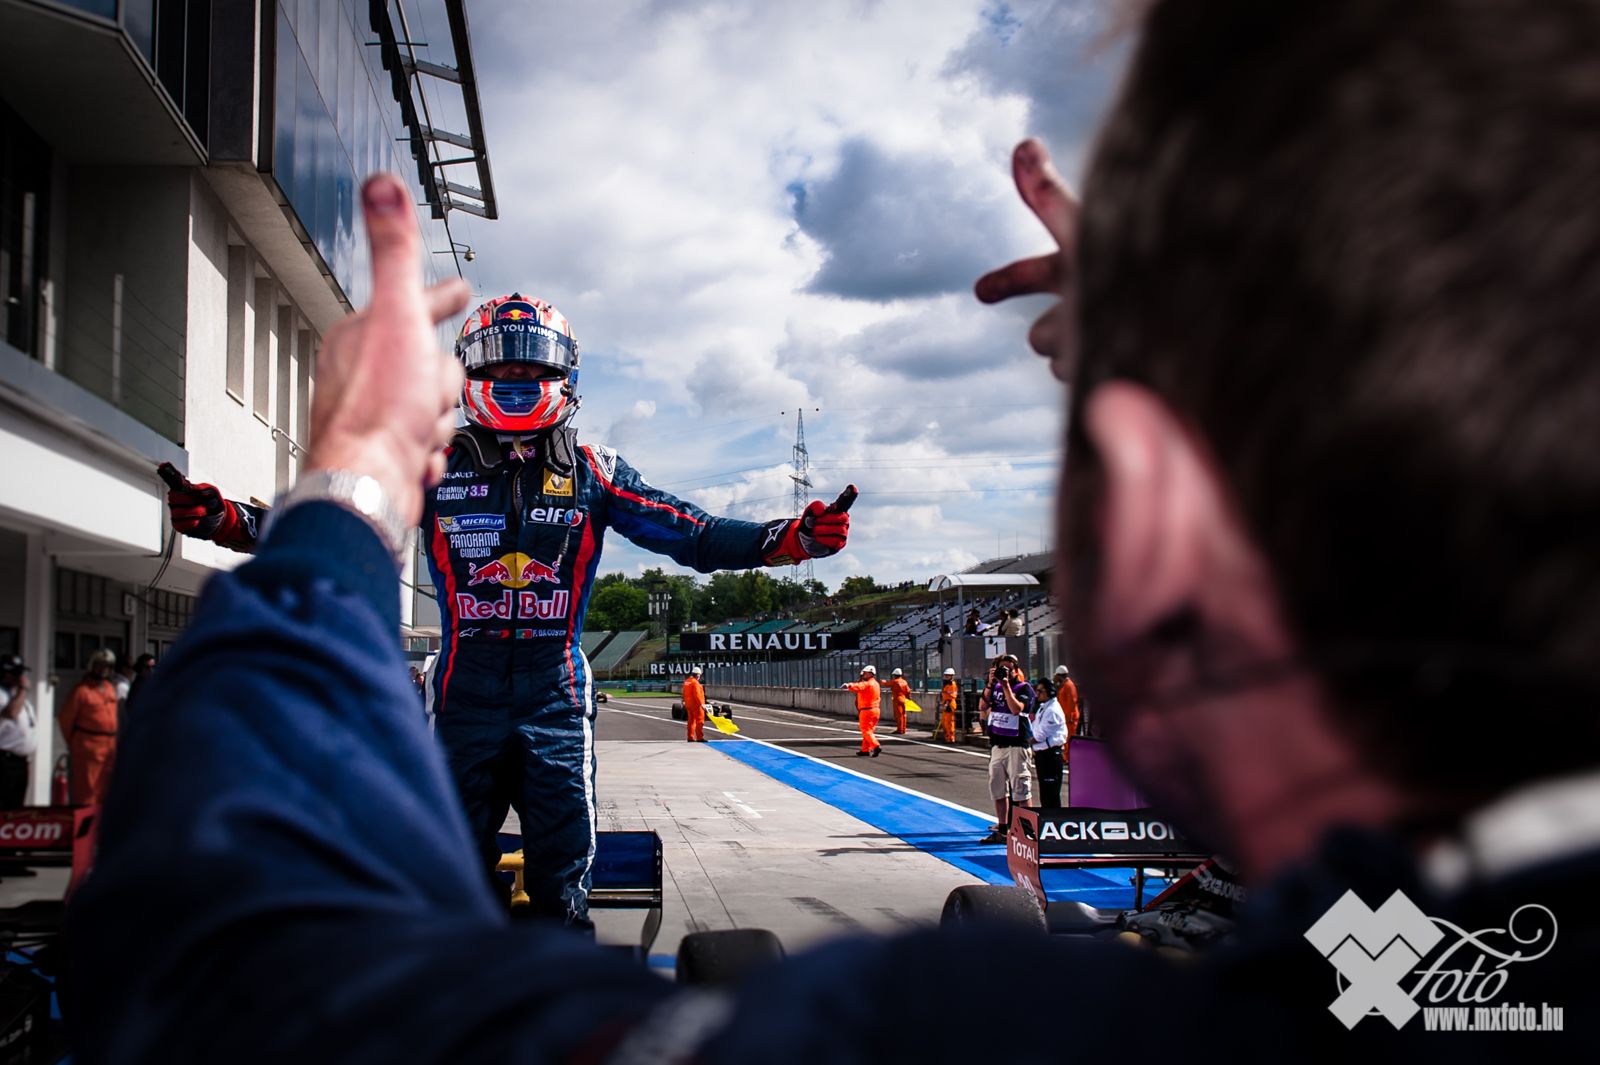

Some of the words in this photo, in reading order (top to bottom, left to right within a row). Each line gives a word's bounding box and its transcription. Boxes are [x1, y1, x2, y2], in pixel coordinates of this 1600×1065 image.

[474, 325, 500, 340] GIVES
[502, 324, 525, 333] YOU
[527, 325, 559, 341] WINGS
[469, 485, 489, 497] 3.5
[461, 518, 504, 526] MICHELIN
[530, 507, 565, 523] elf
[450, 531, 501, 549] PANORAMA
[459, 546, 491, 558] GUINCHO
[456, 590, 513, 620] Red
[517, 590, 569, 619] Bull
[709, 633, 832, 650] RENAULT
[1011, 835, 1038, 865] TOTAL
